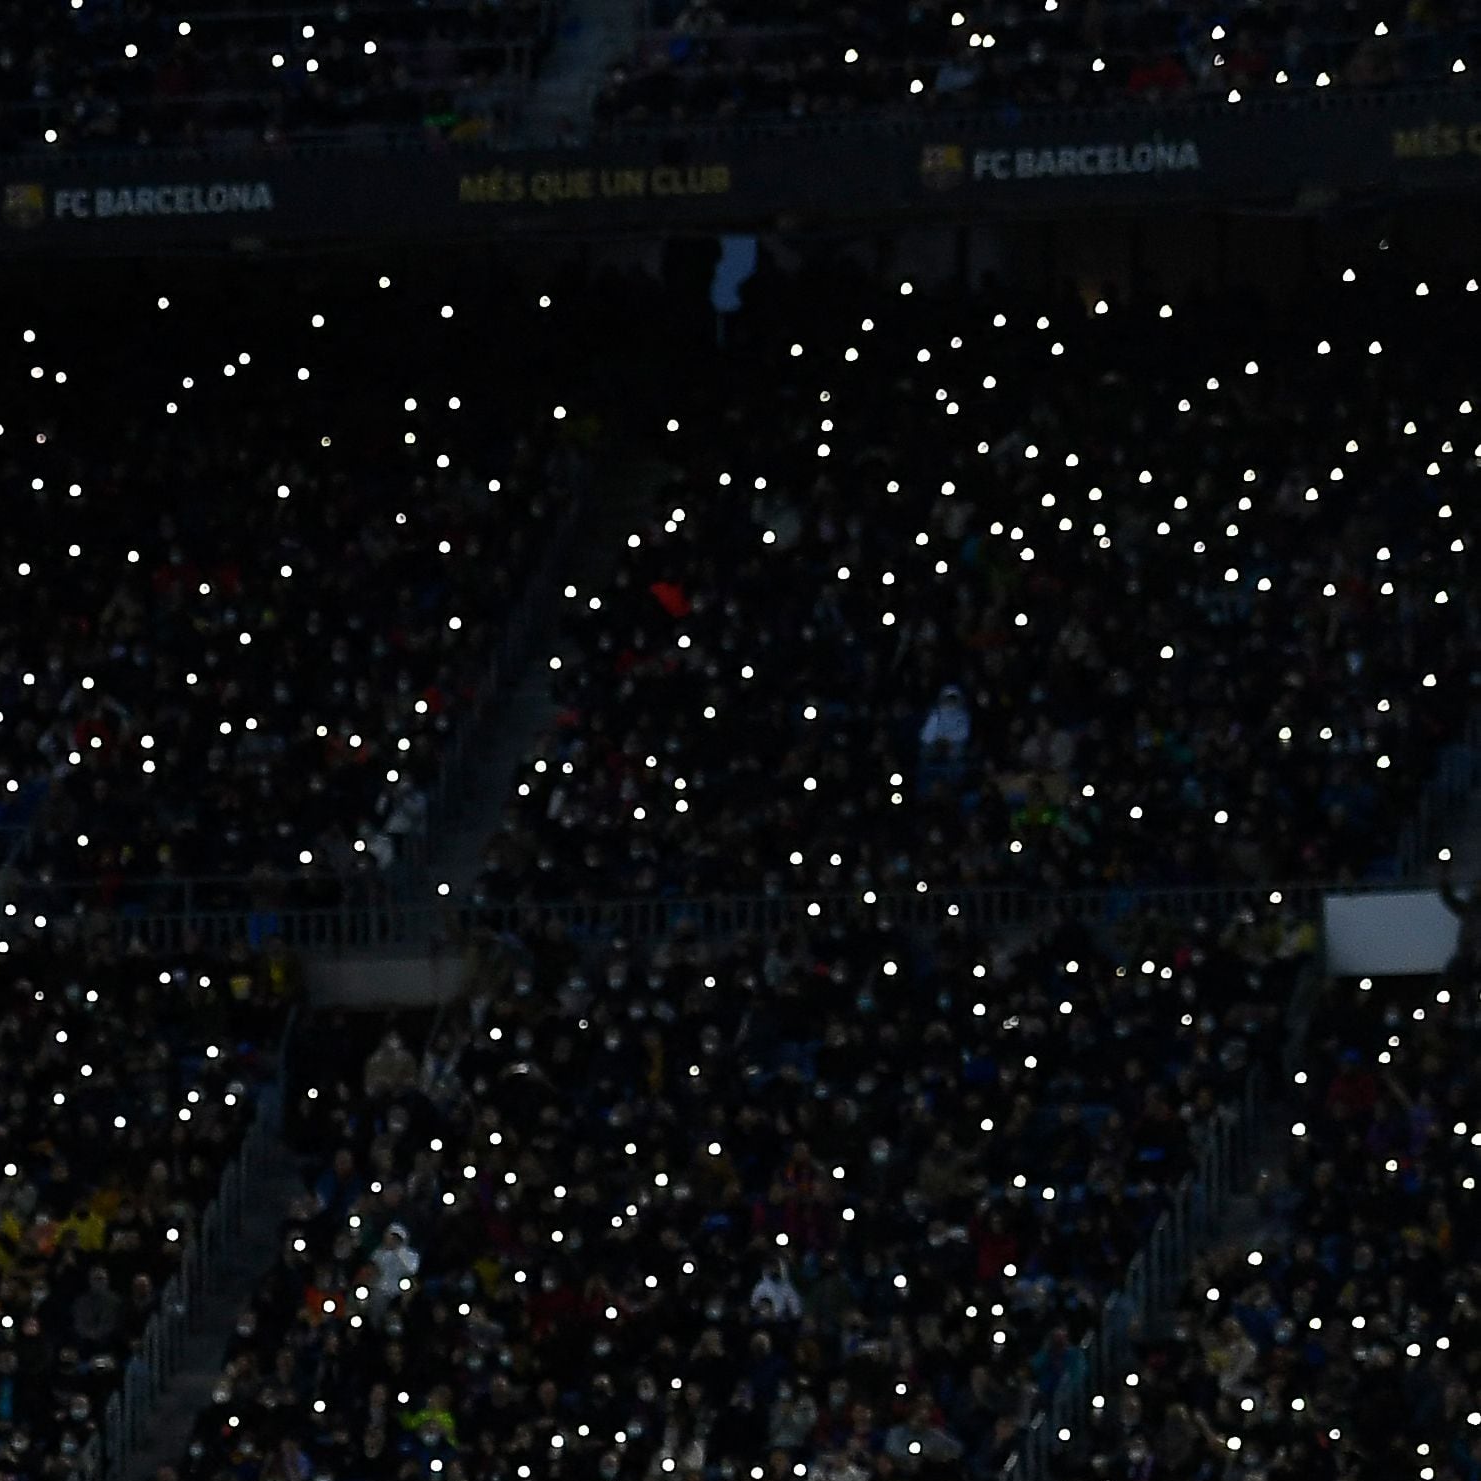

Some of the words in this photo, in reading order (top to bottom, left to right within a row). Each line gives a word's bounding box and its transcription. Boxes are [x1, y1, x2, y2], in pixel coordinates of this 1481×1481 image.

[974, 148, 1006, 180] FC
[1011, 141, 1200, 179] BARCELONA
[649, 163, 731, 197] CLUB
[54, 189, 87, 219] FC
[91, 181, 274, 217] BARCELONA
